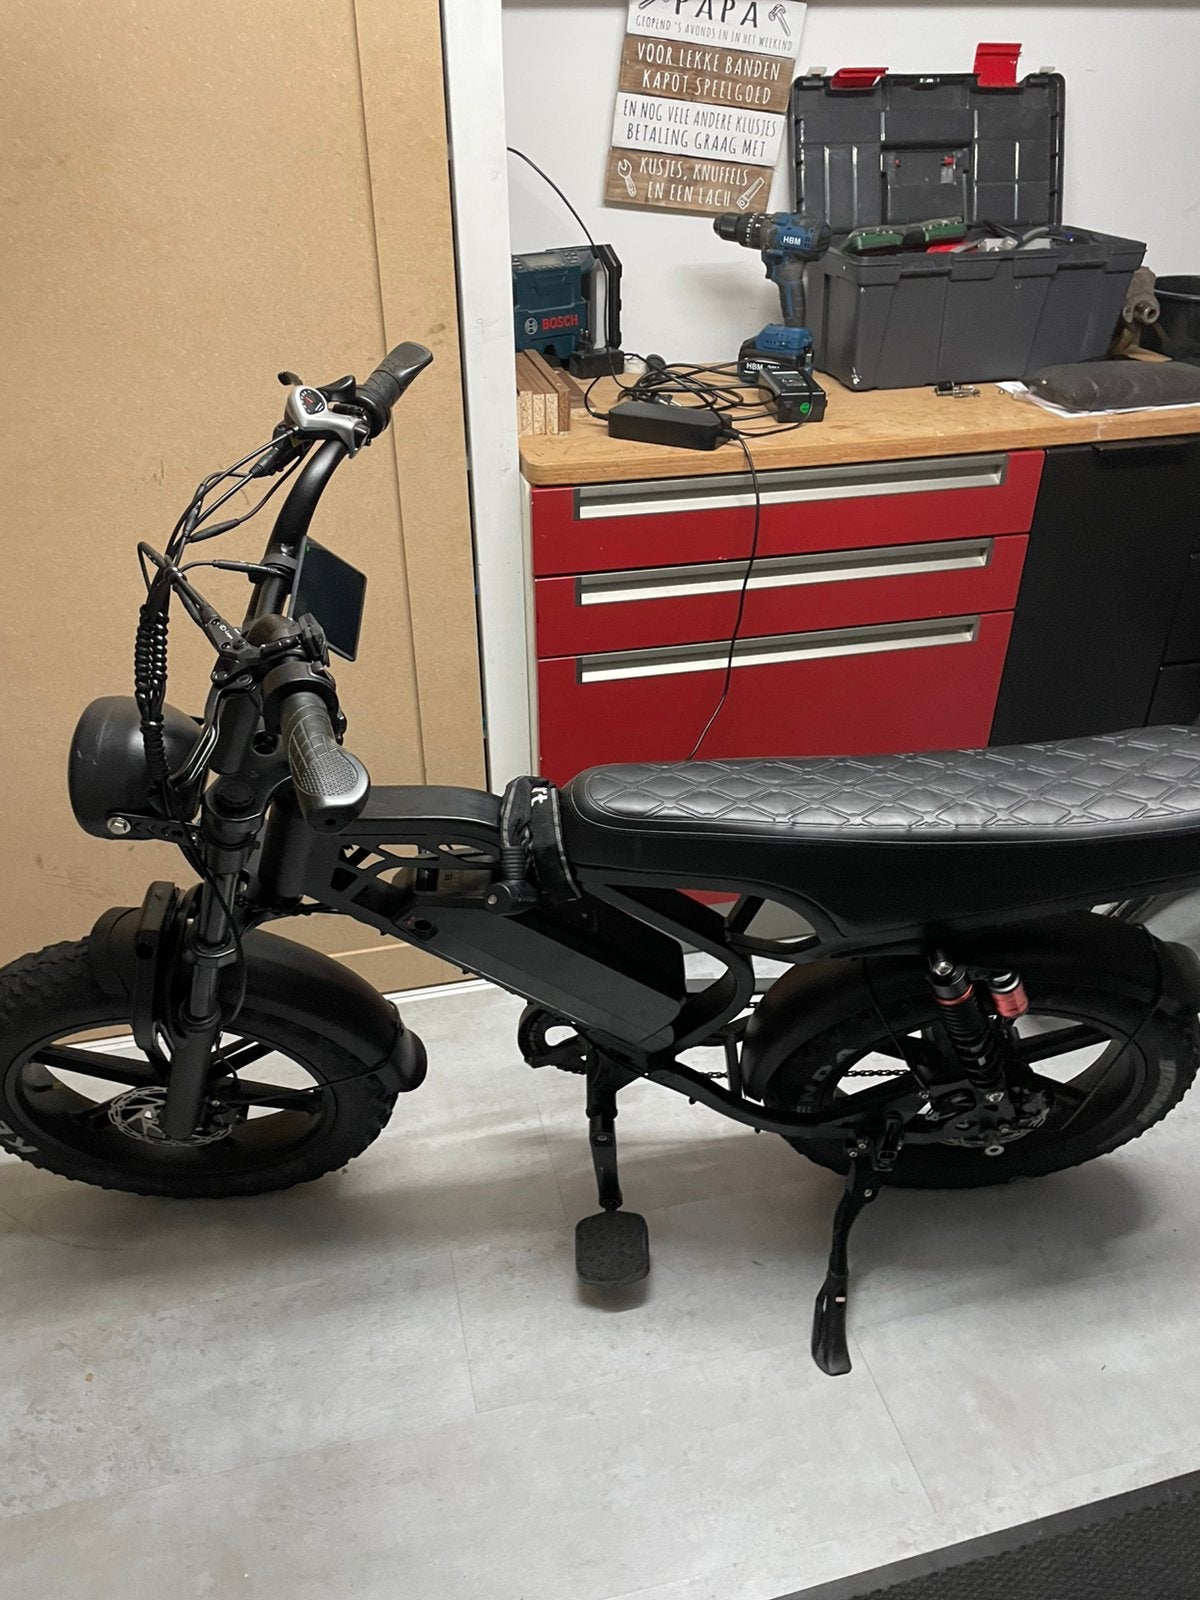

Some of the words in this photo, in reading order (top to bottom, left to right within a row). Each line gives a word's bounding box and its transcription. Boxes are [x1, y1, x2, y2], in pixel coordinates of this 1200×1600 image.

[635, 14, 672, 31] GEOPEND
[684, 23, 716, 39] AVONDS
[718, 27, 729, 41] EN
[730, 30, 740, 43] IN
[743, 32, 756, 46] HET
[758, 35, 793, 51] WEEKEND
[637, 42, 673, 66] VOOR
[679, 48, 720, 73] LEKKE
[725, 56, 781, 81] BANDEN
[642, 69, 689, 93] KAPOT
[694, 77, 771, 105] SPEELGOED
[623, 99, 637, 117] EN
[640, 101, 663, 122] NOG
[668, 105, 691, 126] VELE
[693, 110, 732, 131] ANDERE
[735, 115, 777, 138] KLUSJES
[627, 122, 689, 148] BETALING
[694, 132, 737, 155] GRAAG
[741, 138, 766, 158] MET
[639, 156, 688, 181] KUSJES,
[693, 163, 749, 187] KNUFFELS
[647, 181, 665, 199] EN
[669, 183, 694, 203] EEN
[698, 188, 731, 208] LACH
[782, 235, 802, 246] HBM
[541, 313, 579, 332] BOSCH
[746, 361, 764, 371] HBM
